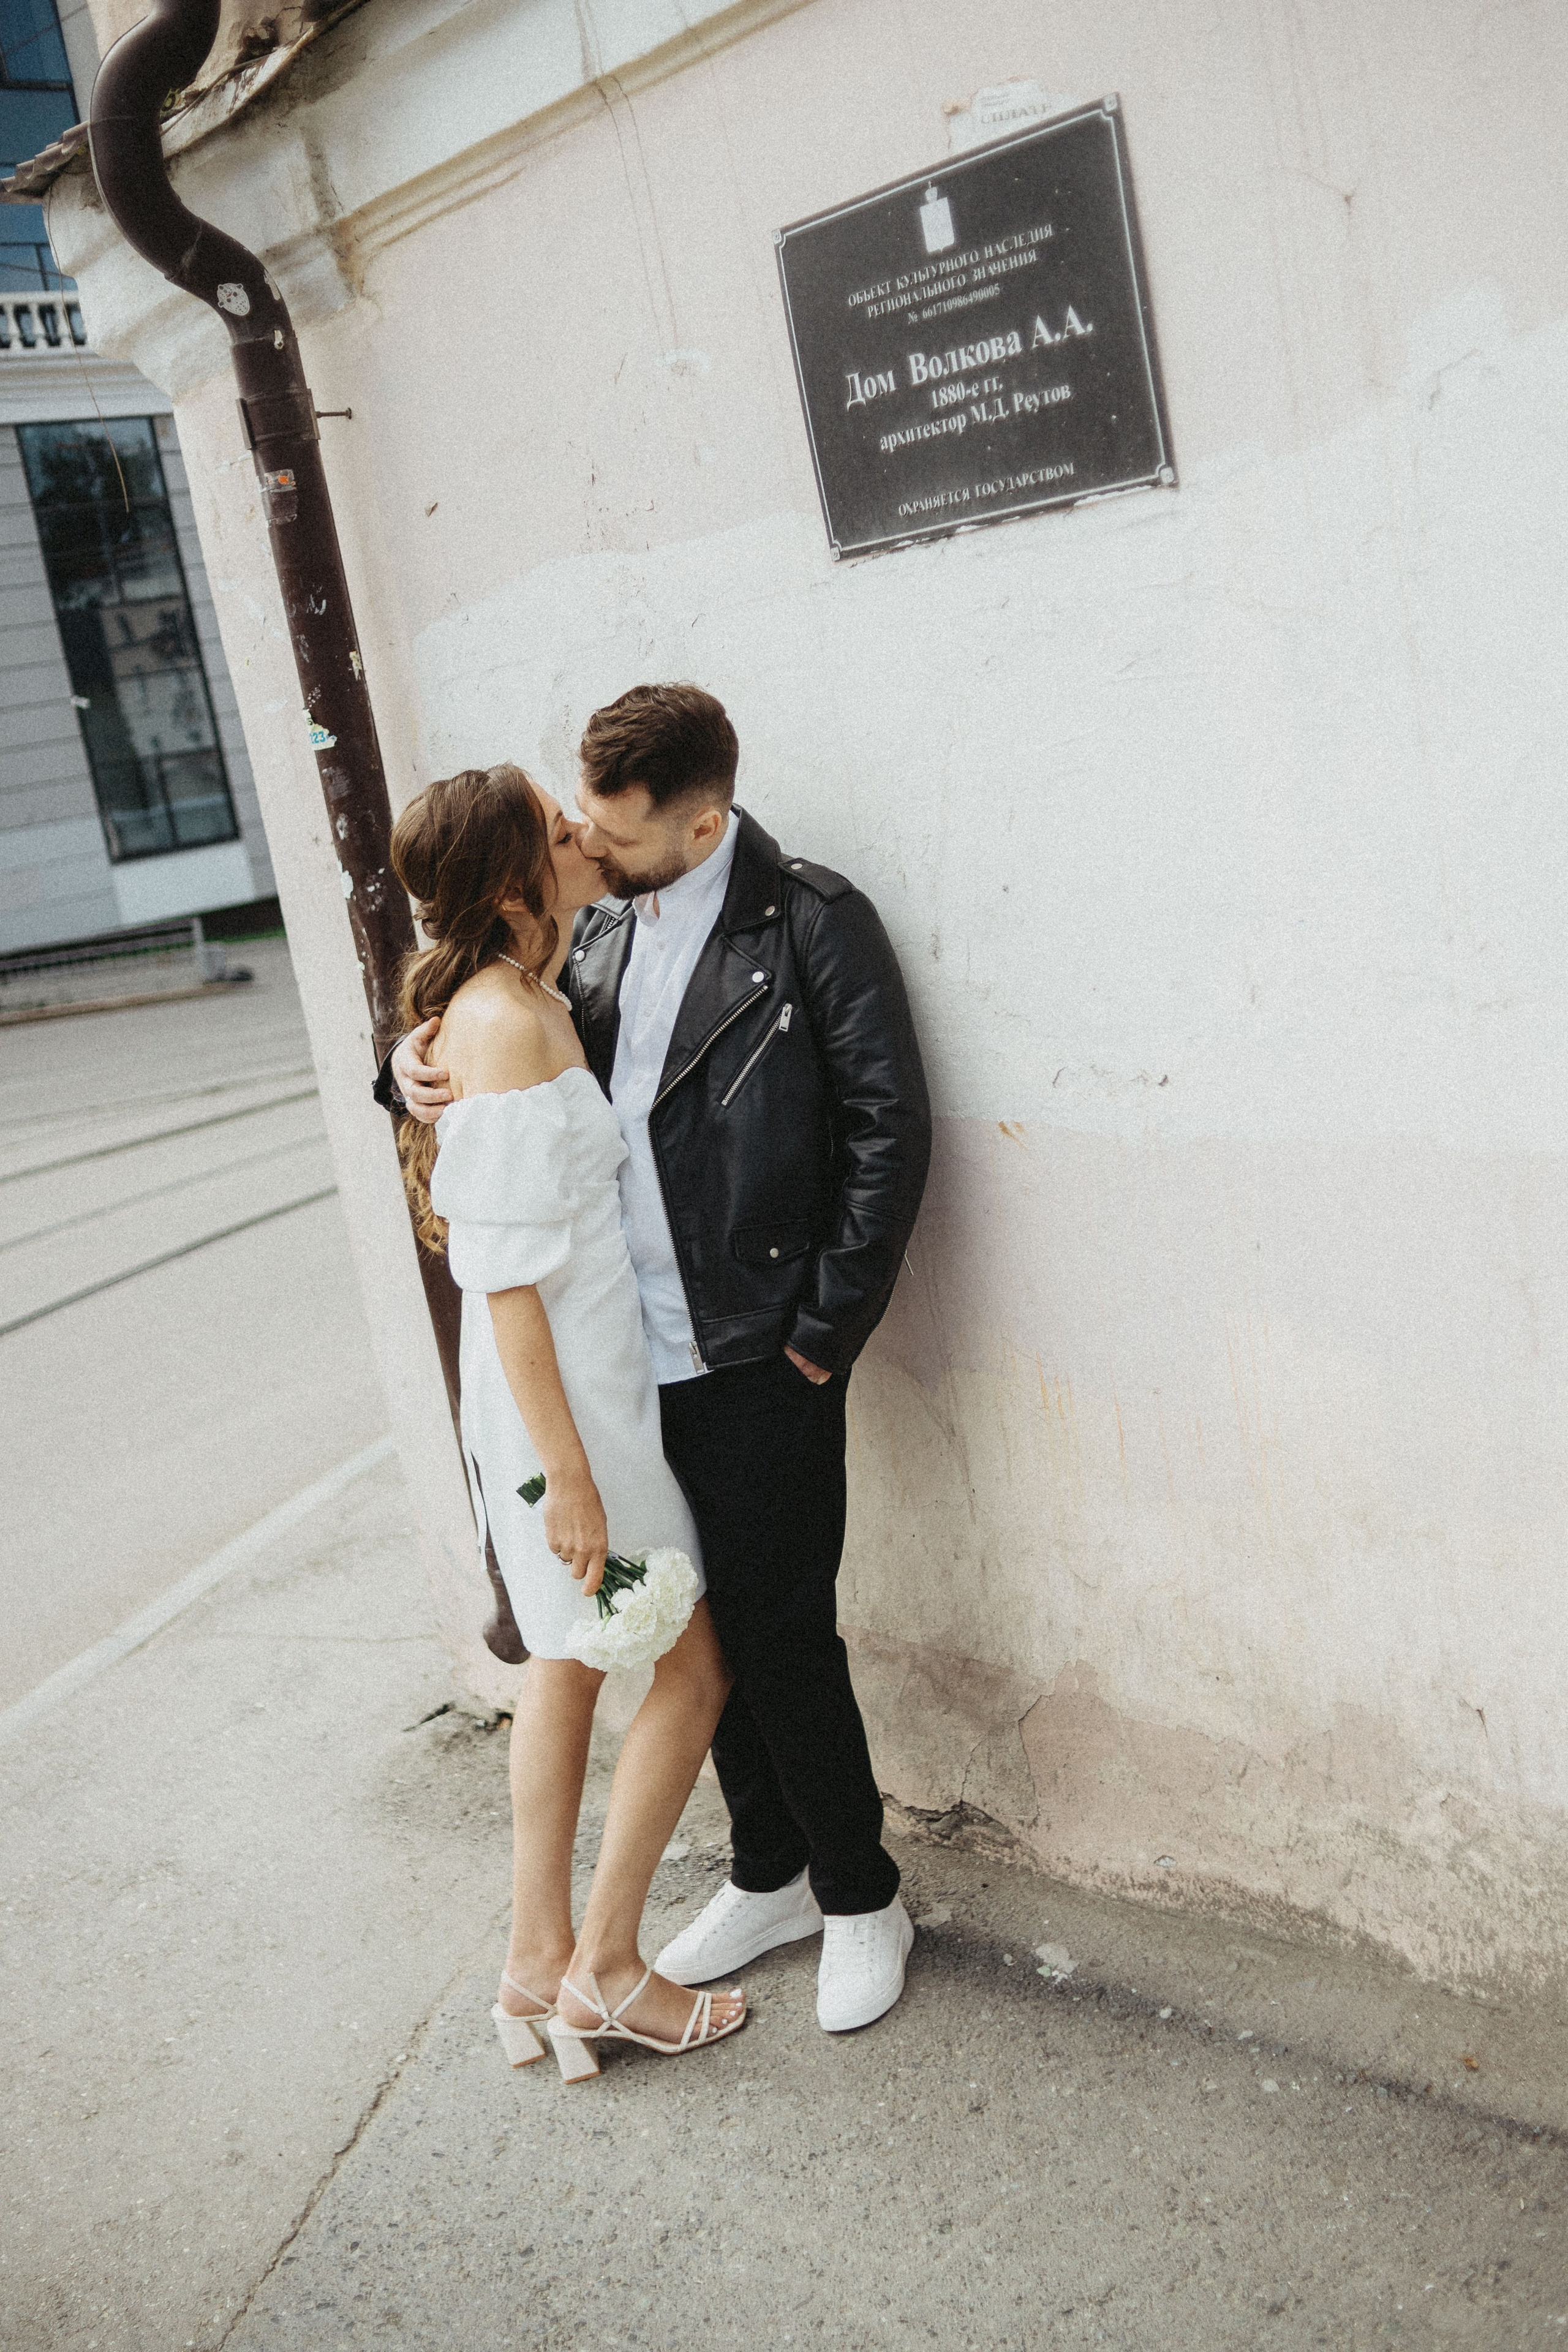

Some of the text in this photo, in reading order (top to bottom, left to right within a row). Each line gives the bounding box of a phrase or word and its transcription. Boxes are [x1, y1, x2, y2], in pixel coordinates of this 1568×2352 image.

[848, 224, 1053, 307] ОБЪЕКТ КУЛЬТУРНОГО НАСЛЕДИЯ
[867, 249, 1038, 318] РЕГИОНАЛЬНОГО ЗНАЧЕНИЯ
[908, 311, 918, 325] №
[845, 305, 1093, 412] Дом Волкова А.А.
[932, 376, 1003, 408] 1880-е гг.
[880, 385, 1071, 453] архитектор М.Д. Реутов
[899, 462, 1075, 517] ОХРАНЯЕТСЯ ГОСУДАРСТВОМ
